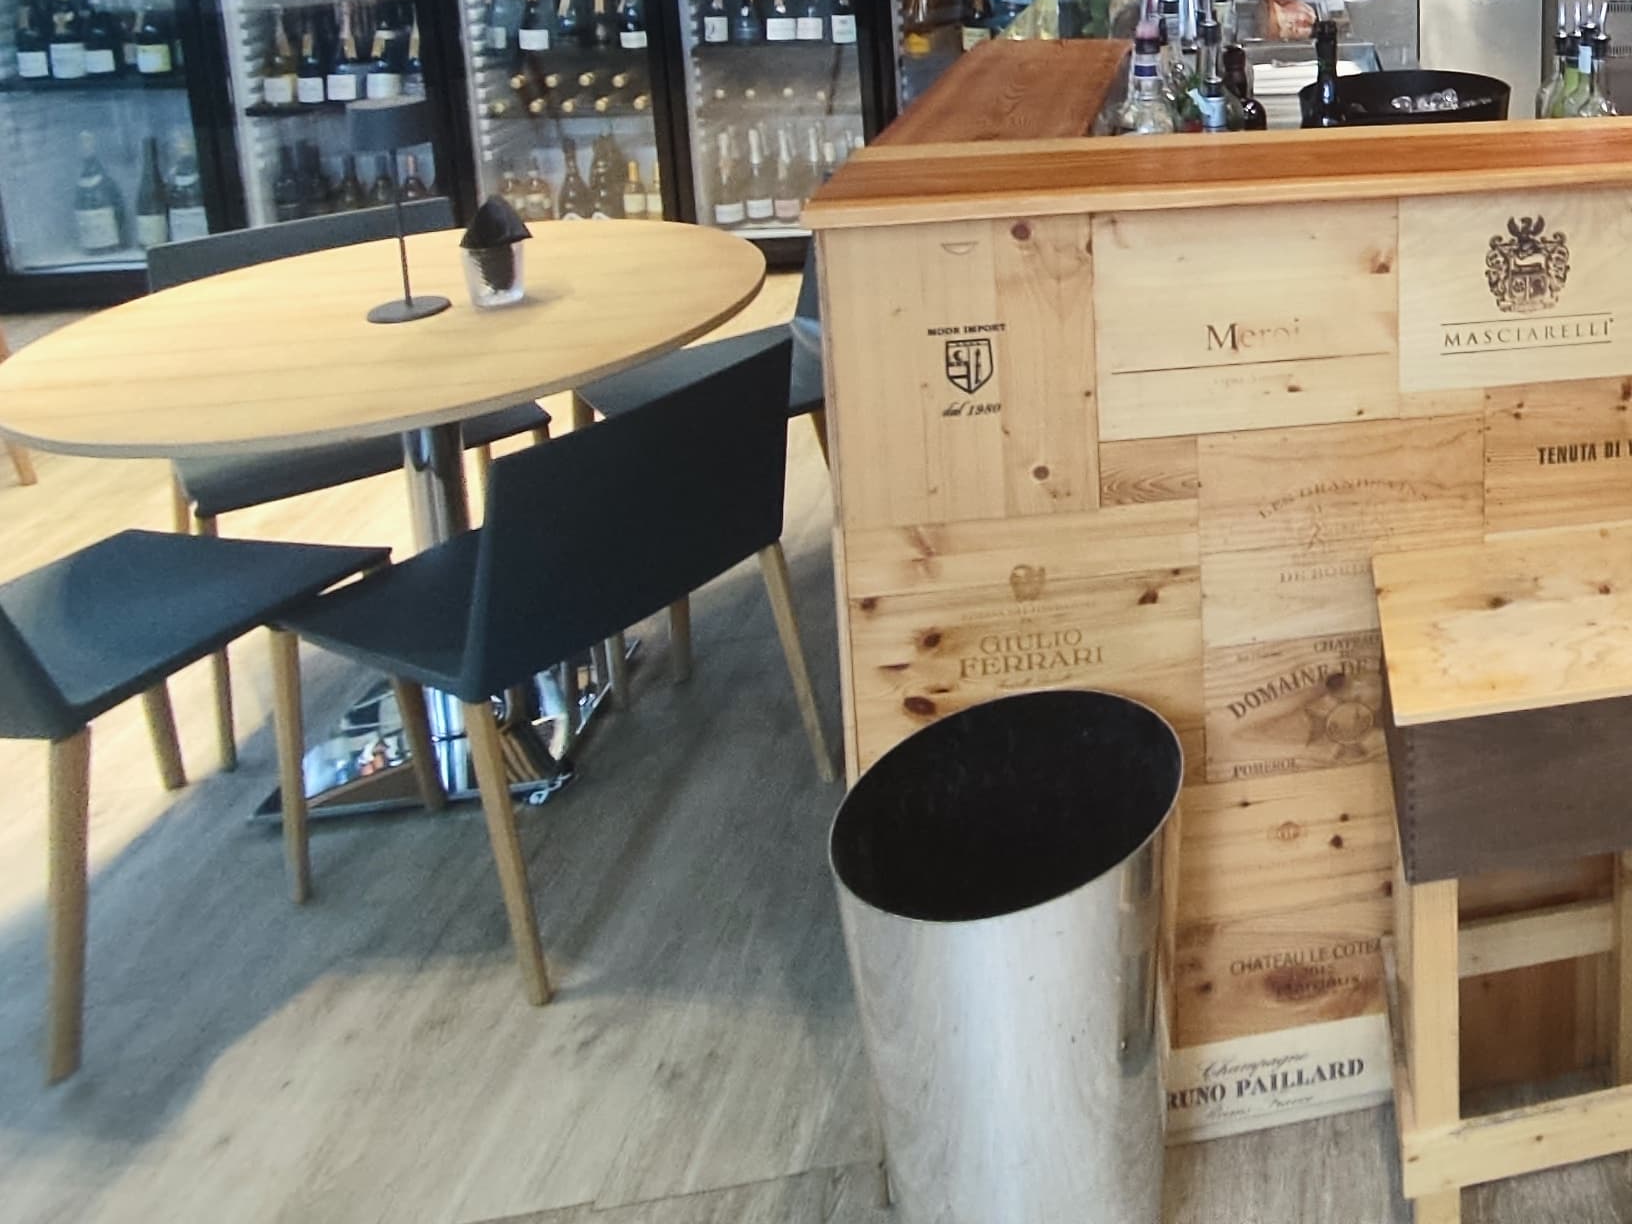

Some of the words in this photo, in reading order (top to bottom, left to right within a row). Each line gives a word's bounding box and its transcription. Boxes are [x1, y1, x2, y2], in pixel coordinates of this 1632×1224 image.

[1444, 319, 1609, 348] MASCIARELLI
[1537, 441, 1597, 466] TENUTA
[1603, 440, 1621, 459] DI
[979, 628, 1082, 655] GIULIO
[959, 646, 1103, 679] FERRARI
[1226, 663, 1329, 721] DOMAINE
[1230, 952, 1304, 977] CHATEAU
[1310, 947, 1327, 963] LE
[1167, 1083, 1227, 1112] RUNO
[1236, 1057, 1365, 1098] PAILLARD
